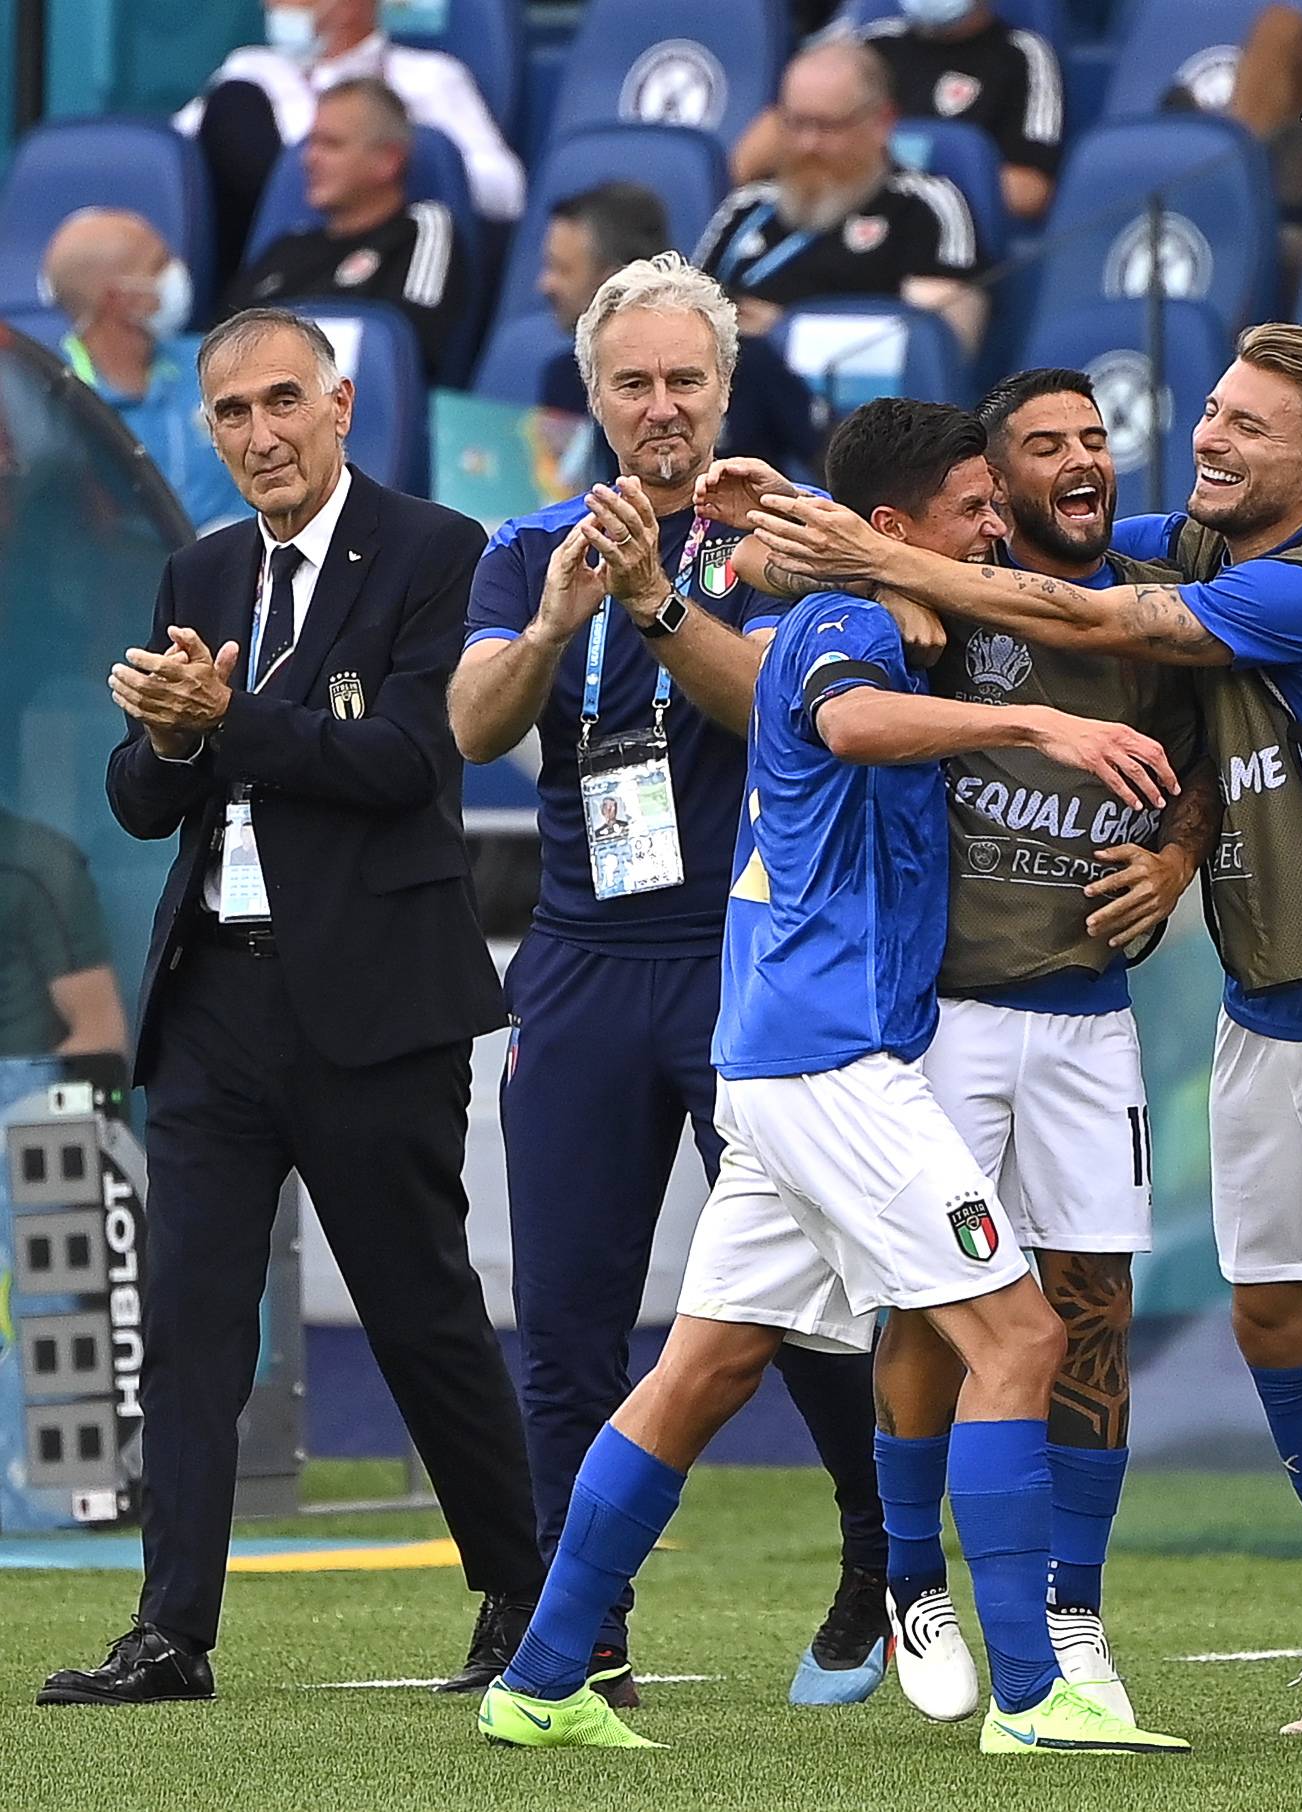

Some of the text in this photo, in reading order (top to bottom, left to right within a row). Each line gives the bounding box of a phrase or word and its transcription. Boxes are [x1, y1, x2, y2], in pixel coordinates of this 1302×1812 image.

[1219, 745, 1287, 806] ME
[954, 776, 1087, 839] EQUAL
[951, 1202, 986, 1224] ITALIA
[102, 1170, 145, 1417] HUBLOT
